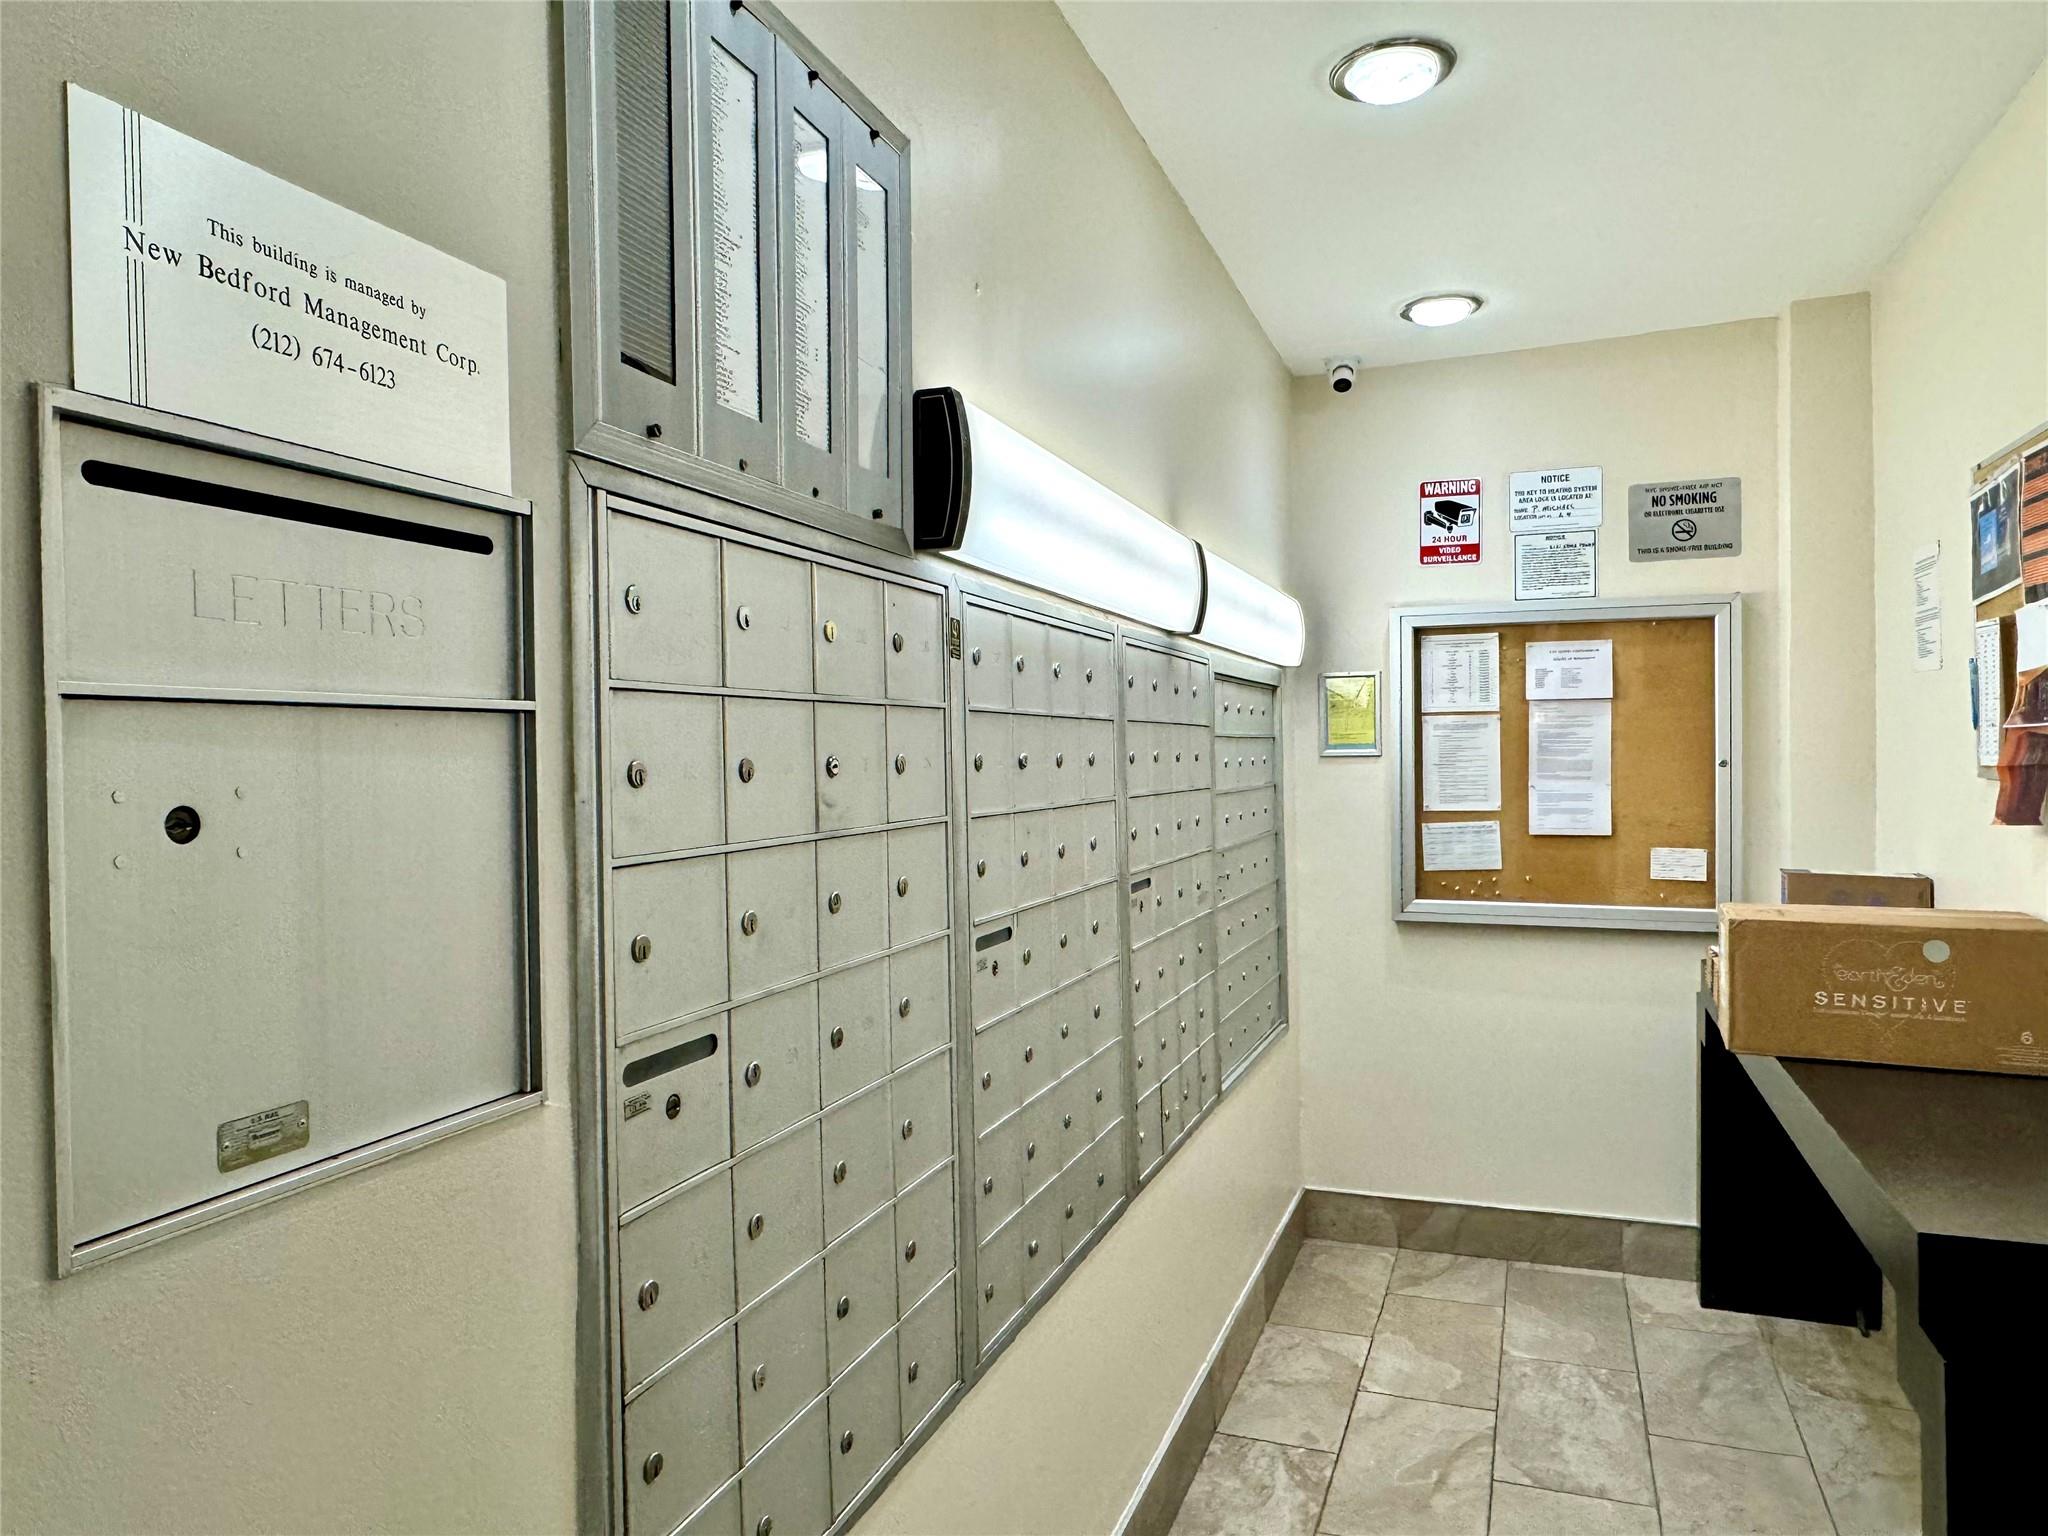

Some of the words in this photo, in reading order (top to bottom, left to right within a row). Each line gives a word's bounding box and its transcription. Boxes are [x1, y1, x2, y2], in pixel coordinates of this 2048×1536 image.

[206, 218, 244, 248] This
[252, 236, 318, 279] building
[325, 266, 337, 283] is
[344, 277, 404, 310] managed
[411, 300, 426, 320] by
[122, 225, 183, 267] New
[196, 253, 292, 308] Bedford
[303, 292, 428, 356] Management
[436, 343, 480, 376] Corp.
[251, 323, 301, 361] (212)
[312, 346, 396, 389] 674-6123
[1540, 474, 1570, 484] NOTICE
[1424, 480, 1476, 496] WARNING
[1652, 495, 1667, 508] NO
[1669, 491, 1717, 507] SMOKING
[1443, 535, 1468, 543] HOUR
[1423, 554, 1477, 563] SURVEILLANCE
[192, 568, 426, 638] LETTERS
[1814, 991, 1966, 1014] SENSITIVE
[2020, 1031, 2033, 1045] 6
